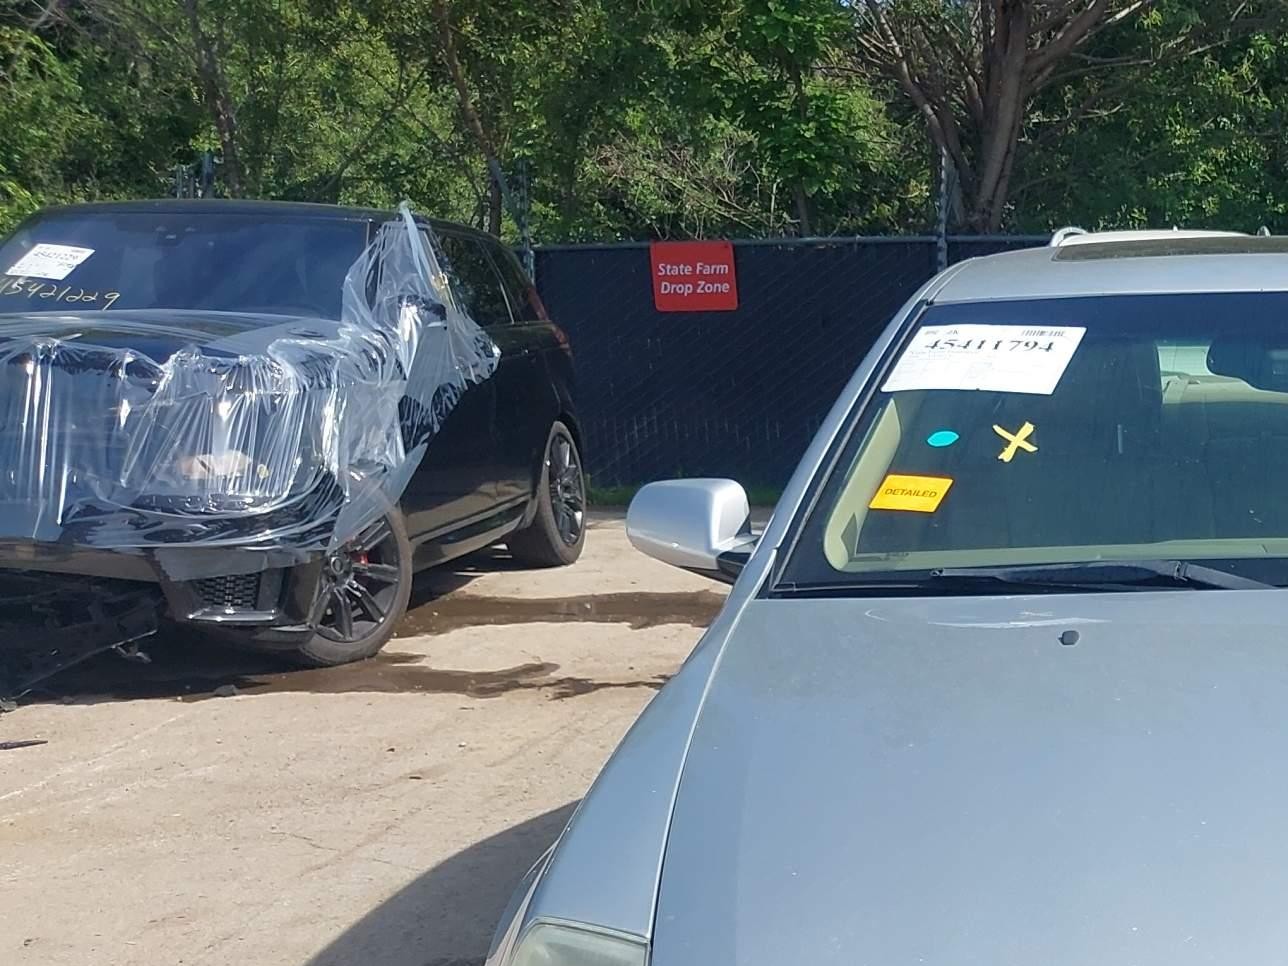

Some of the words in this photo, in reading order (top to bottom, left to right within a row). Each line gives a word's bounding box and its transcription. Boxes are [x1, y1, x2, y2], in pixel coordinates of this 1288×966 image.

[658, 263, 693, 276] State
[696, 262, 729, 275] Farm
[661, 281, 693, 296] Drop
[696, 281, 730, 294] Zone
[924, 338, 1055, 353] 45411794
[884, 487, 938, 499] DETAILED
